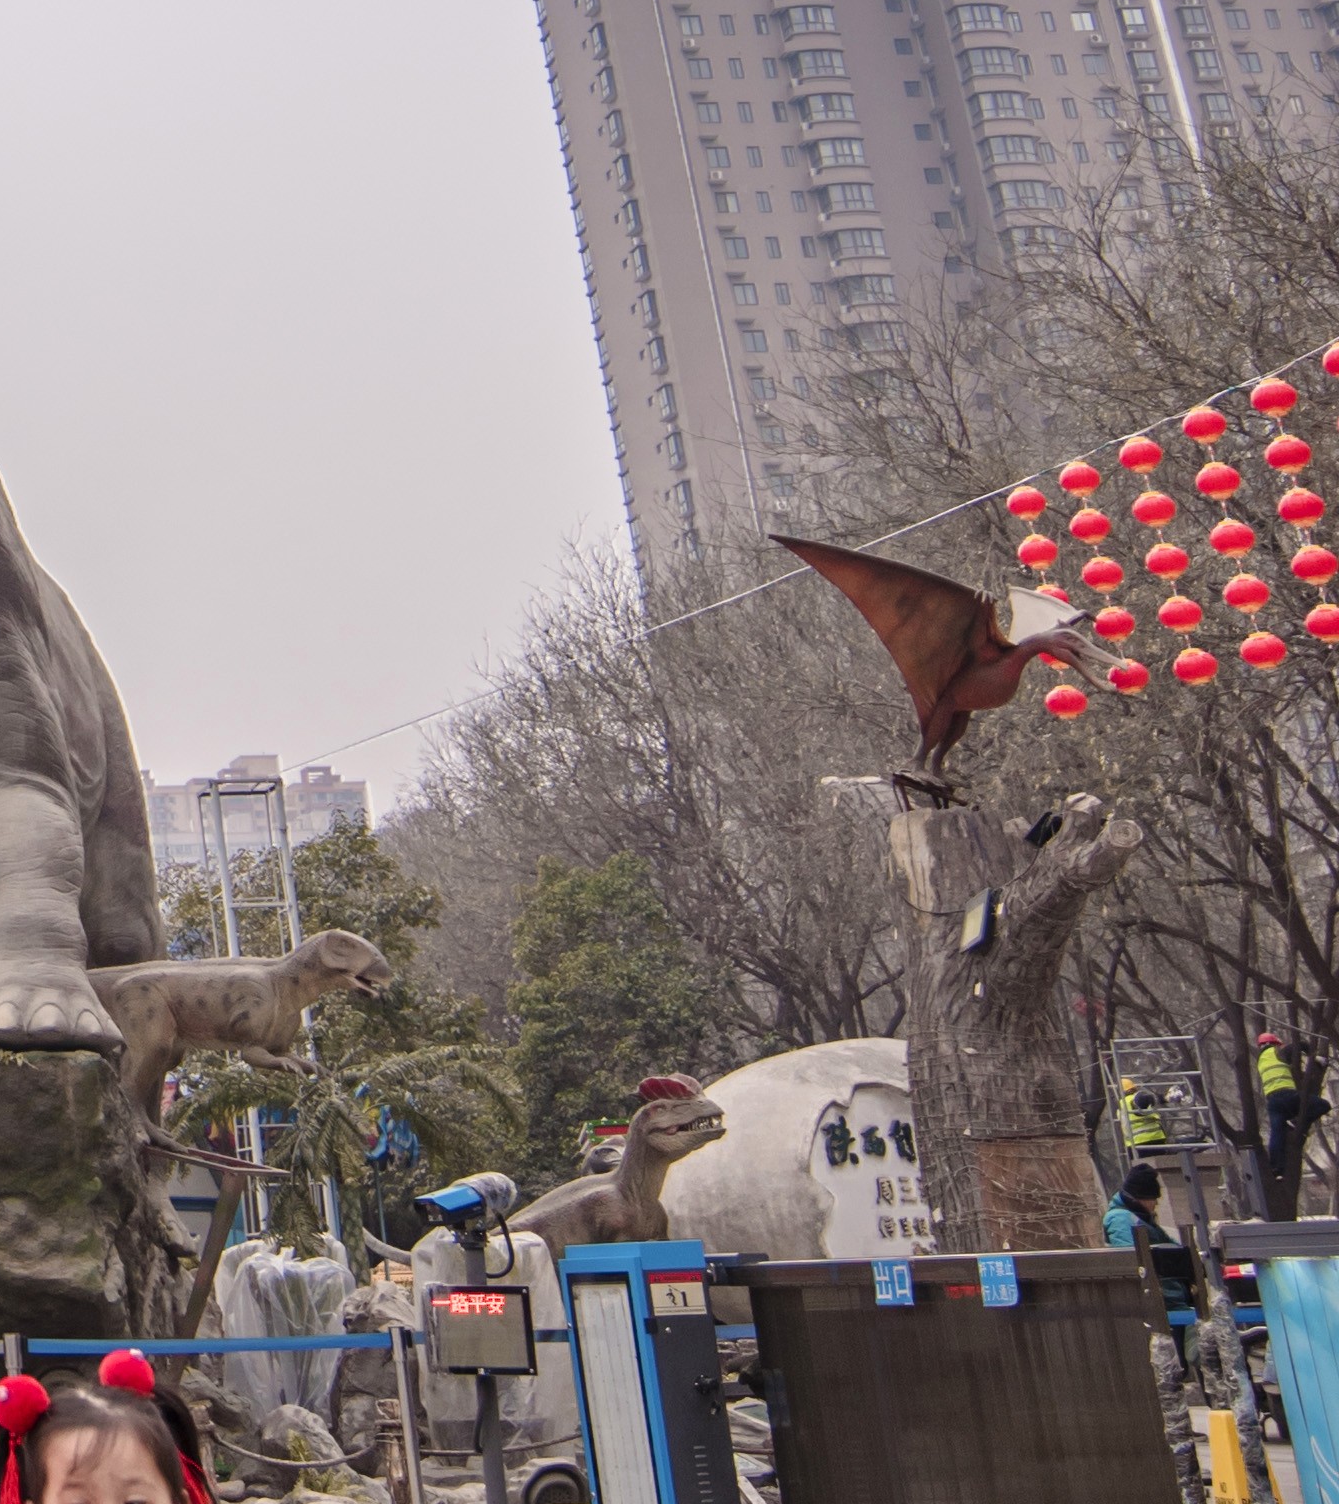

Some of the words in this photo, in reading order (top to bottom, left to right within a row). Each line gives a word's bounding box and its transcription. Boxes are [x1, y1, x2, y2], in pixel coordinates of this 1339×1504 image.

[874, 1262, 911, 1300] 出口
[432, 1293, 505, 1314] 一路平安
